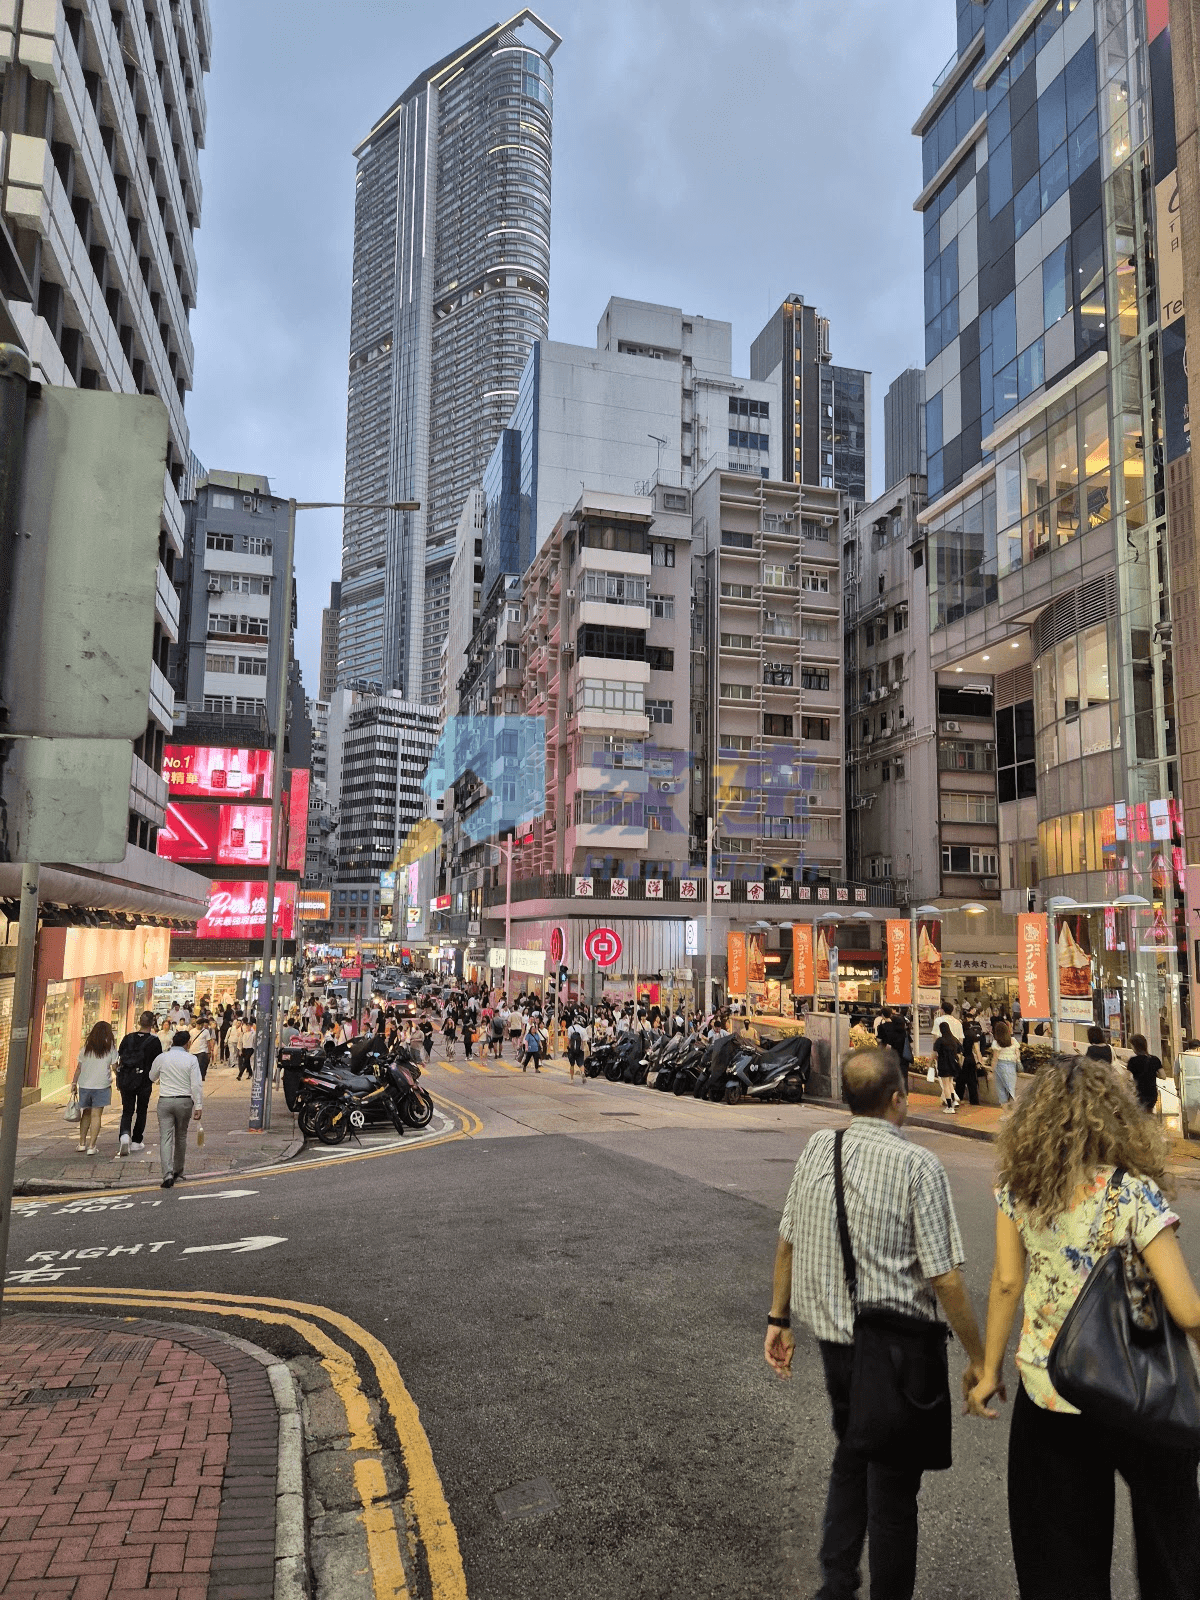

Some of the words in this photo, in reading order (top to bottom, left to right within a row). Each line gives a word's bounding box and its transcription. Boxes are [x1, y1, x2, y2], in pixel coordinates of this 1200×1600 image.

[576, 877, 764, 900] 香港洋務工會
[780, 887, 866, 901] 九龍遊樂部
[51, 1200, 163, 1215] LOOK
[26, 1240, 175, 1262] RIGHT
[4, 1264, 82, 1283] 右
